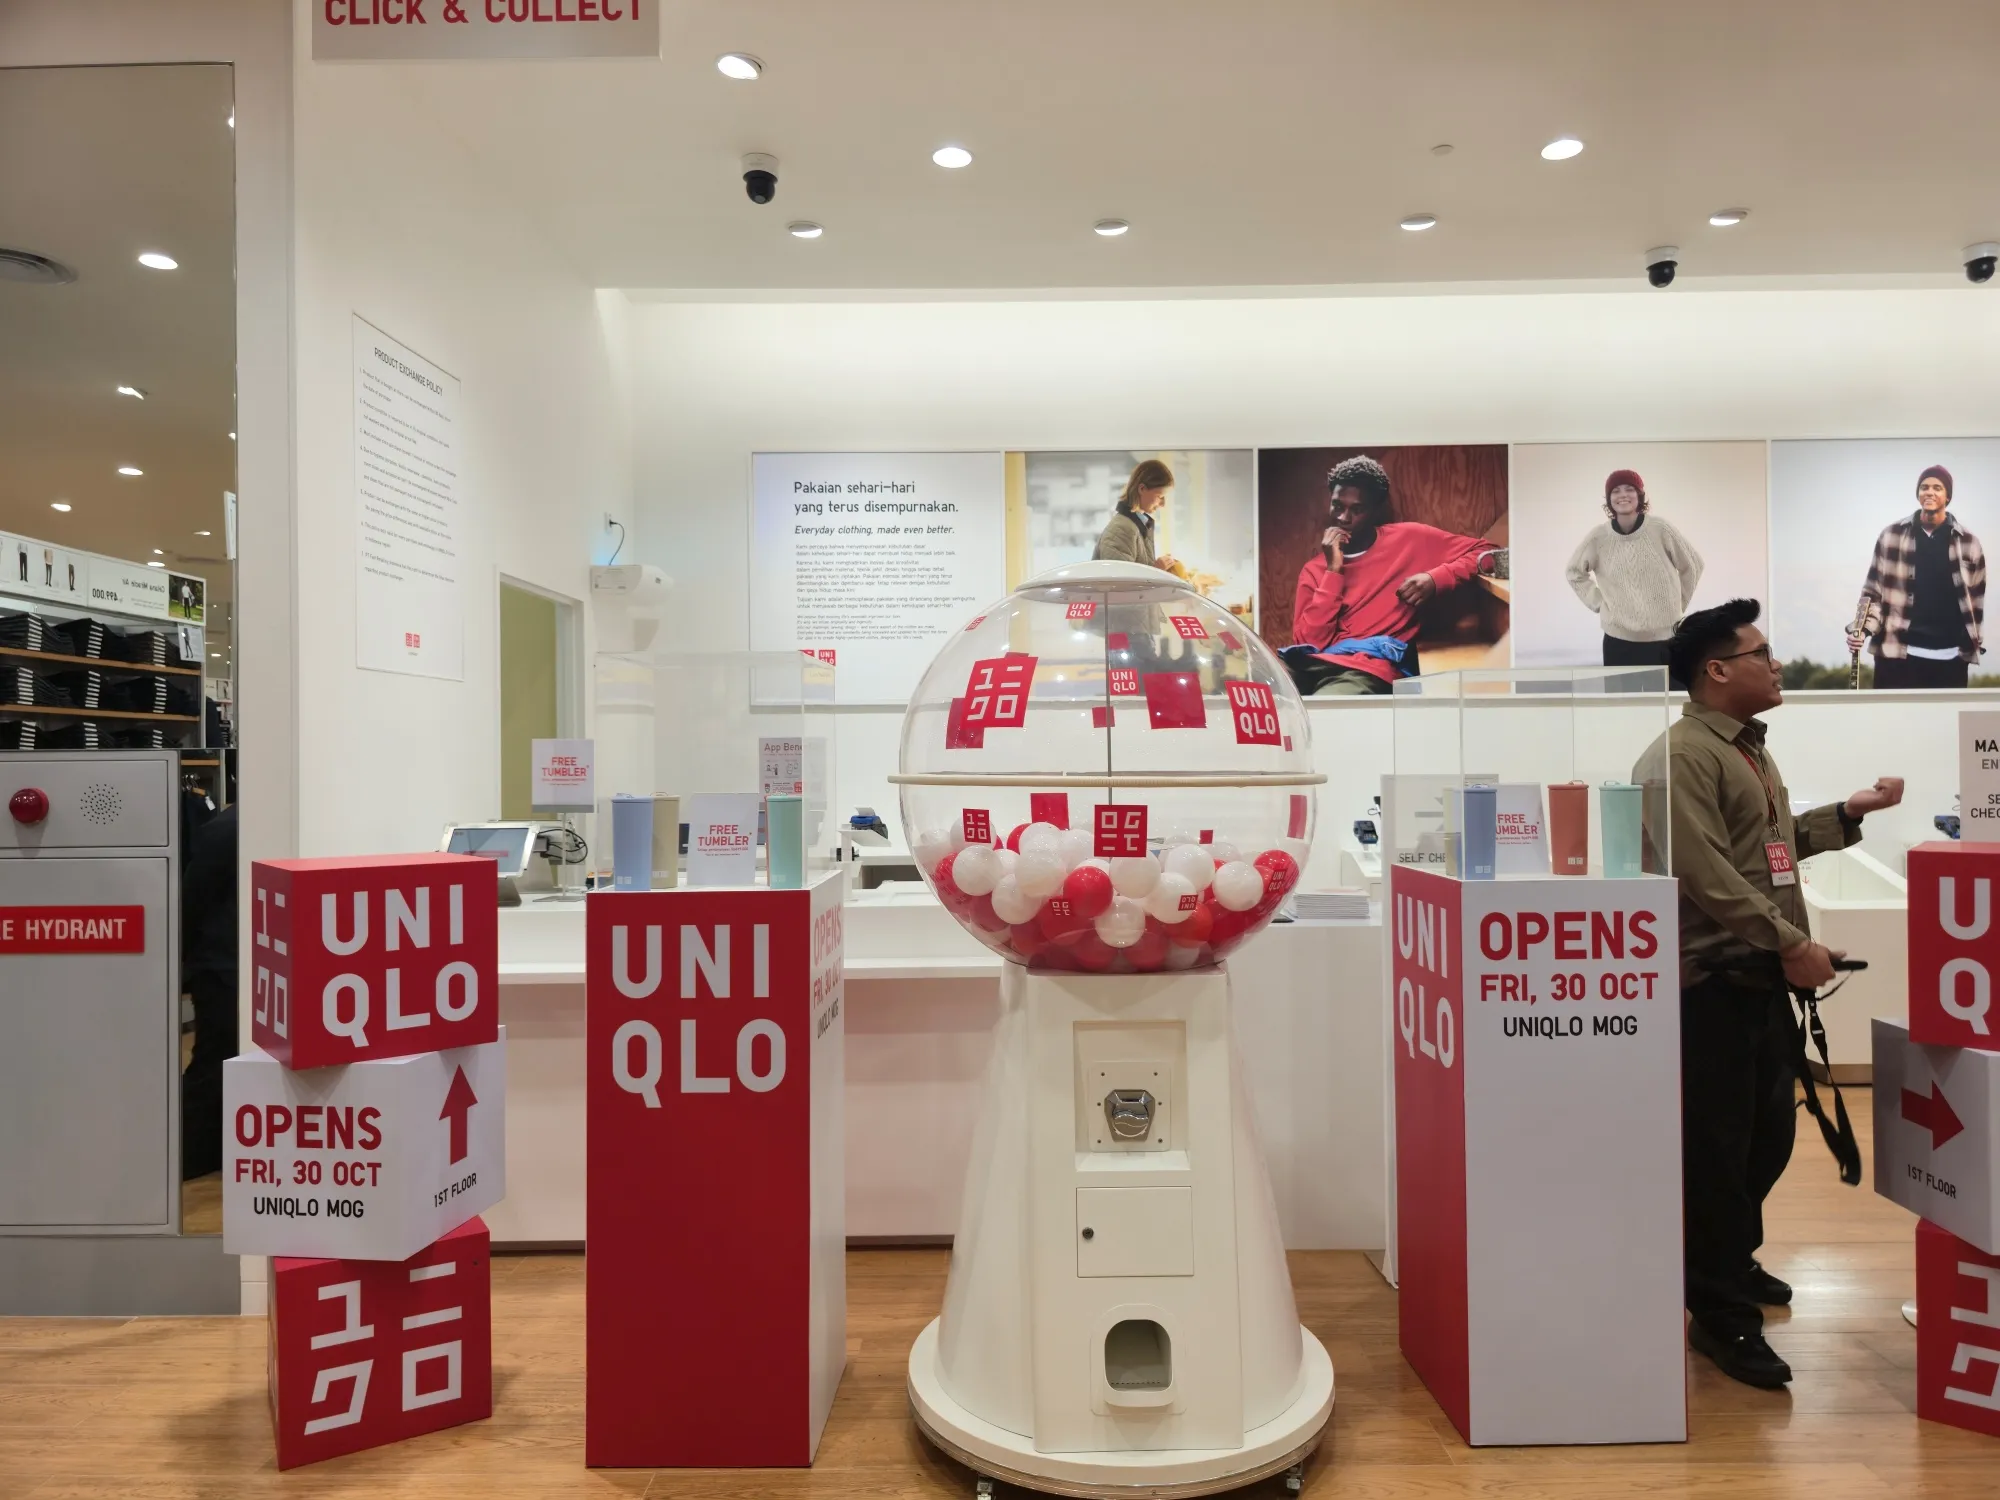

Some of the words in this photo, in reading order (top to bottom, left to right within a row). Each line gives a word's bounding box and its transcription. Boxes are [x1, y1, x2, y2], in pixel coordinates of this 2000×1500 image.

[324, 0, 427, 25] CLICK
[374, 347, 398, 370] PRODUCT
[399, 362, 426, 387] EXCHANGE
[426, 378, 443, 397] POLICY
[794, 481, 842, 493] Pakaian
[847, 481, 915, 493] sehari-hari
[794, 503, 823, 516] yang
[829, 501, 859, 512] terus
[865, 500, 959, 515] disempurnakan.
[795, 525, 835, 536] Everyday
[838, 525, 873, 536] clothing,
[877, 525, 900, 534] made
[904, 526, 923, 534] even
[926, 525, 955, 534] better.
[1111, 671, 1133, 681] UNI
[1113, 681, 1136, 691] QLO
[1232, 686, 1269, 709] UNI
[1239, 712, 1276, 738] QLO
[764, 743, 781, 753] App
[551, 756, 577, 766] FREE
[1982, 759, 2000, 769] EN
[709, 824, 738, 835] FREE
[1496, 821, 1540, 835] UMBLER
[1497, 814, 1525, 823] FREE
[1399, 853, 1424, 863] SELF
[1768, 848, 1786, 858] UNI
[1771, 859, 1790, 871] QLO
[0, 920, 14, 940] E
[25, 919, 127, 940] HYDRANT
[321, 884, 463, 955] UNI
[813, 902, 842, 967] OPENS
[1397, 893, 1447, 978] UNI
[1480, 910, 1658, 961] OPENS
[612, 923, 769, 999] UNI
[824, 967, 831, 995] 30
[1480, 973, 1537, 1006] FRI,
[1550, 973, 1586, 1001] 30
[1600, 972, 1659, 1001] OCT
[322, 961, 478, 1048] QLO
[1400, 977, 1454, 1068] QLO
[1503, 1016, 1583, 1039] UNIQLO
[1593, 1015, 1638, 1036] MOG
[612, 1018, 786, 1108] QLO
[235, 1104, 382, 1151] OPENS
[235, 1158, 282, 1187] FRI,
[293, 1160, 322, 1185] 30
[333, 1161, 382, 1187] OCT
[1907, 1164, 1924, 1182] 1ST
[1926, 1173, 1957, 1199] FLOOR
[434, 1188, 449, 1208] 1ST
[451, 1172, 477, 1198] FLOOR
[253, 1197, 319, 1218] UNIQLO
[327, 1200, 364, 1218] MOG
